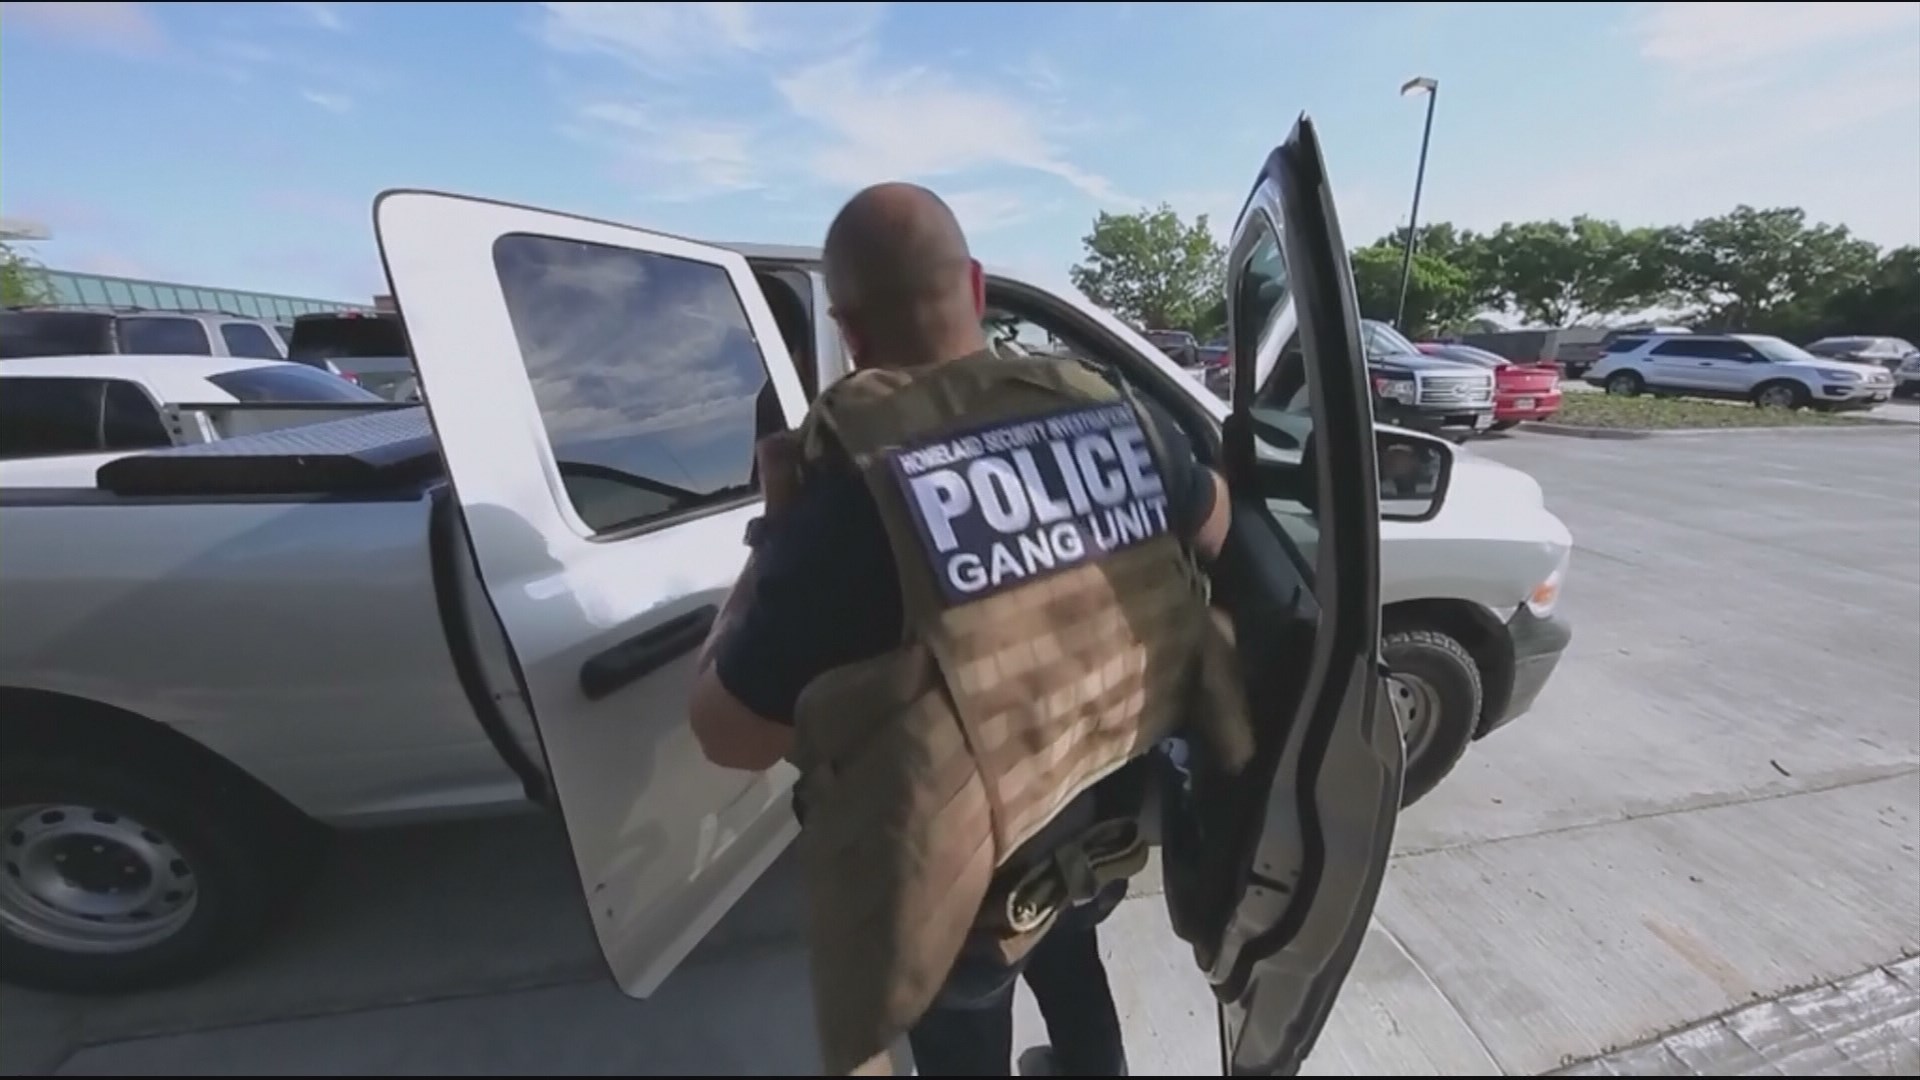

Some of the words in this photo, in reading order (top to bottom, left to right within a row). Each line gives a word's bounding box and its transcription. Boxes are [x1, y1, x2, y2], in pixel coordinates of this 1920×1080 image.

[910, 424, 1164, 553] POLICE
[947, 522, 1086, 593] GANG
[1088, 496, 1168, 551] UNIT
